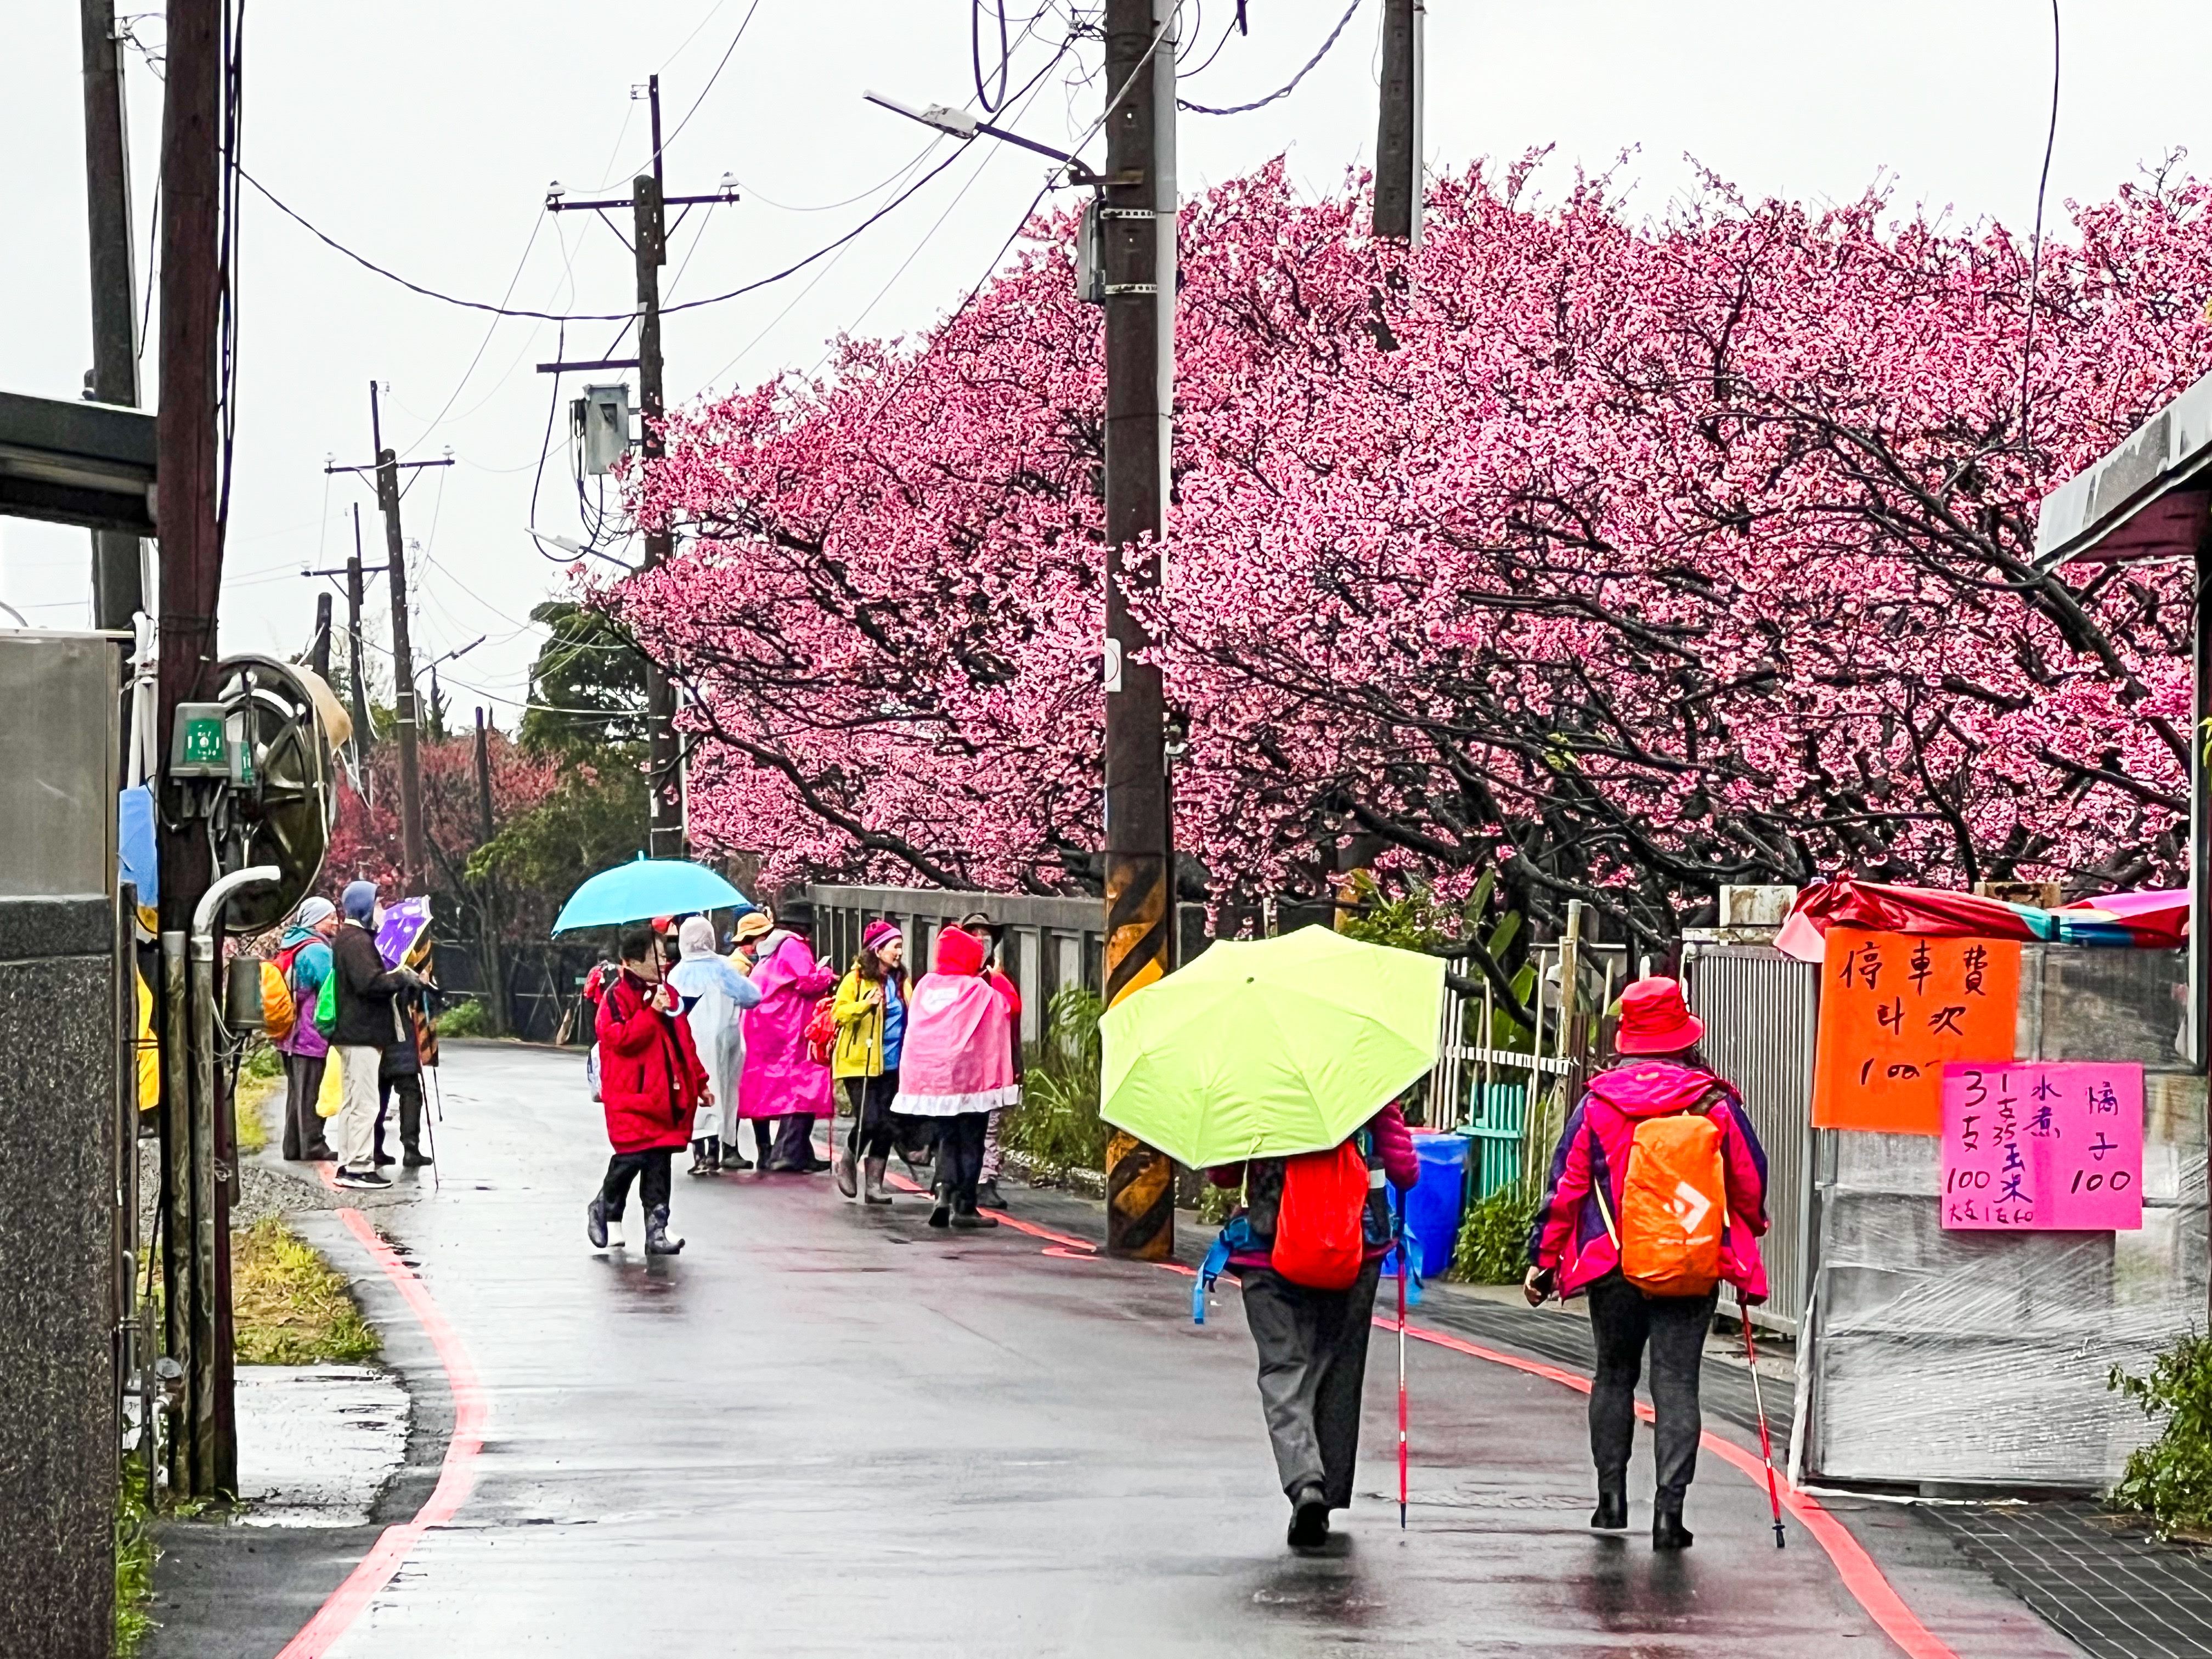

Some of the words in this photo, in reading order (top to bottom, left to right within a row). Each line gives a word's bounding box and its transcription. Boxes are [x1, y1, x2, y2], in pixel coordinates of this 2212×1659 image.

[1839, 939, 1988, 996] 停車費
[2023, 1074, 2062, 1138] 水煮
[1947, 1168, 1990, 1194] 100
[1993, 1143, 2033, 1203] 玉米
[2070, 1170, 2131, 1194] 100
